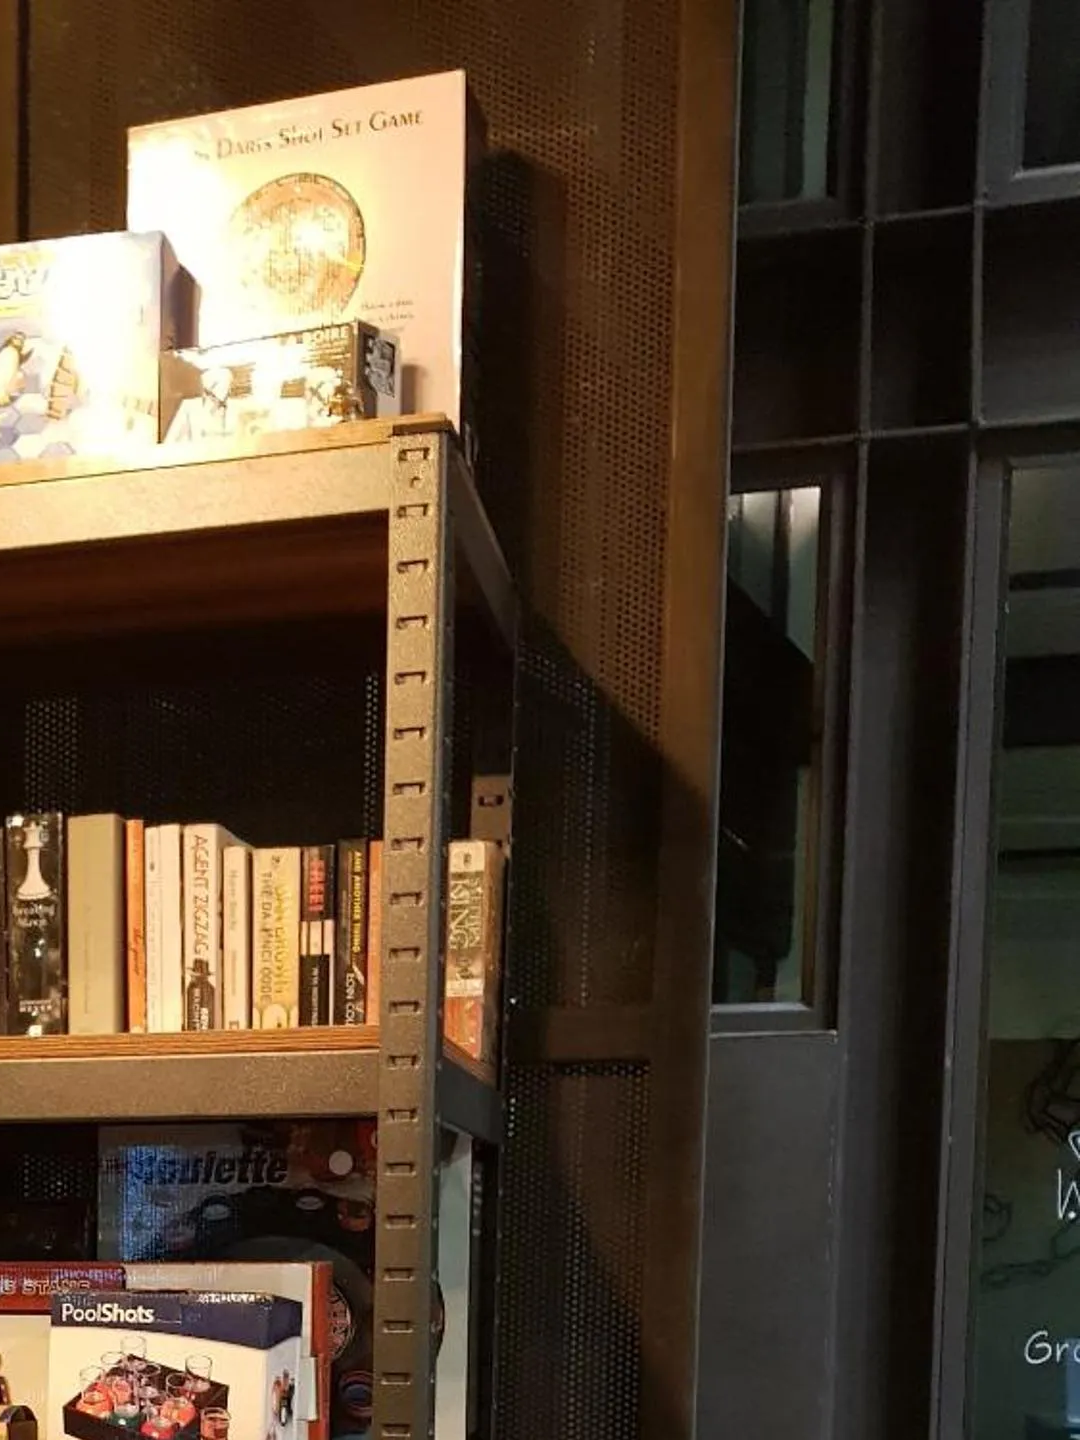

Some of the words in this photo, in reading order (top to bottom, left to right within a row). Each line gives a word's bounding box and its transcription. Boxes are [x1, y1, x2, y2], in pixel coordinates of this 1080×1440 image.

[278, 125, 323, 149] SHOT
[330, 117, 362, 138] SET
[368, 109, 424, 132] GAME
[190, 833, 210, 890] AGENT
[261, 871, 273, 898] THE
[193, 895, 209, 955] ZIGZAG
[261, 902, 273, 920] DA
[449, 879, 469, 950] KING
[261, 967, 274, 1003] CODE
[61, 1303, 156, 1324] PoolShots
